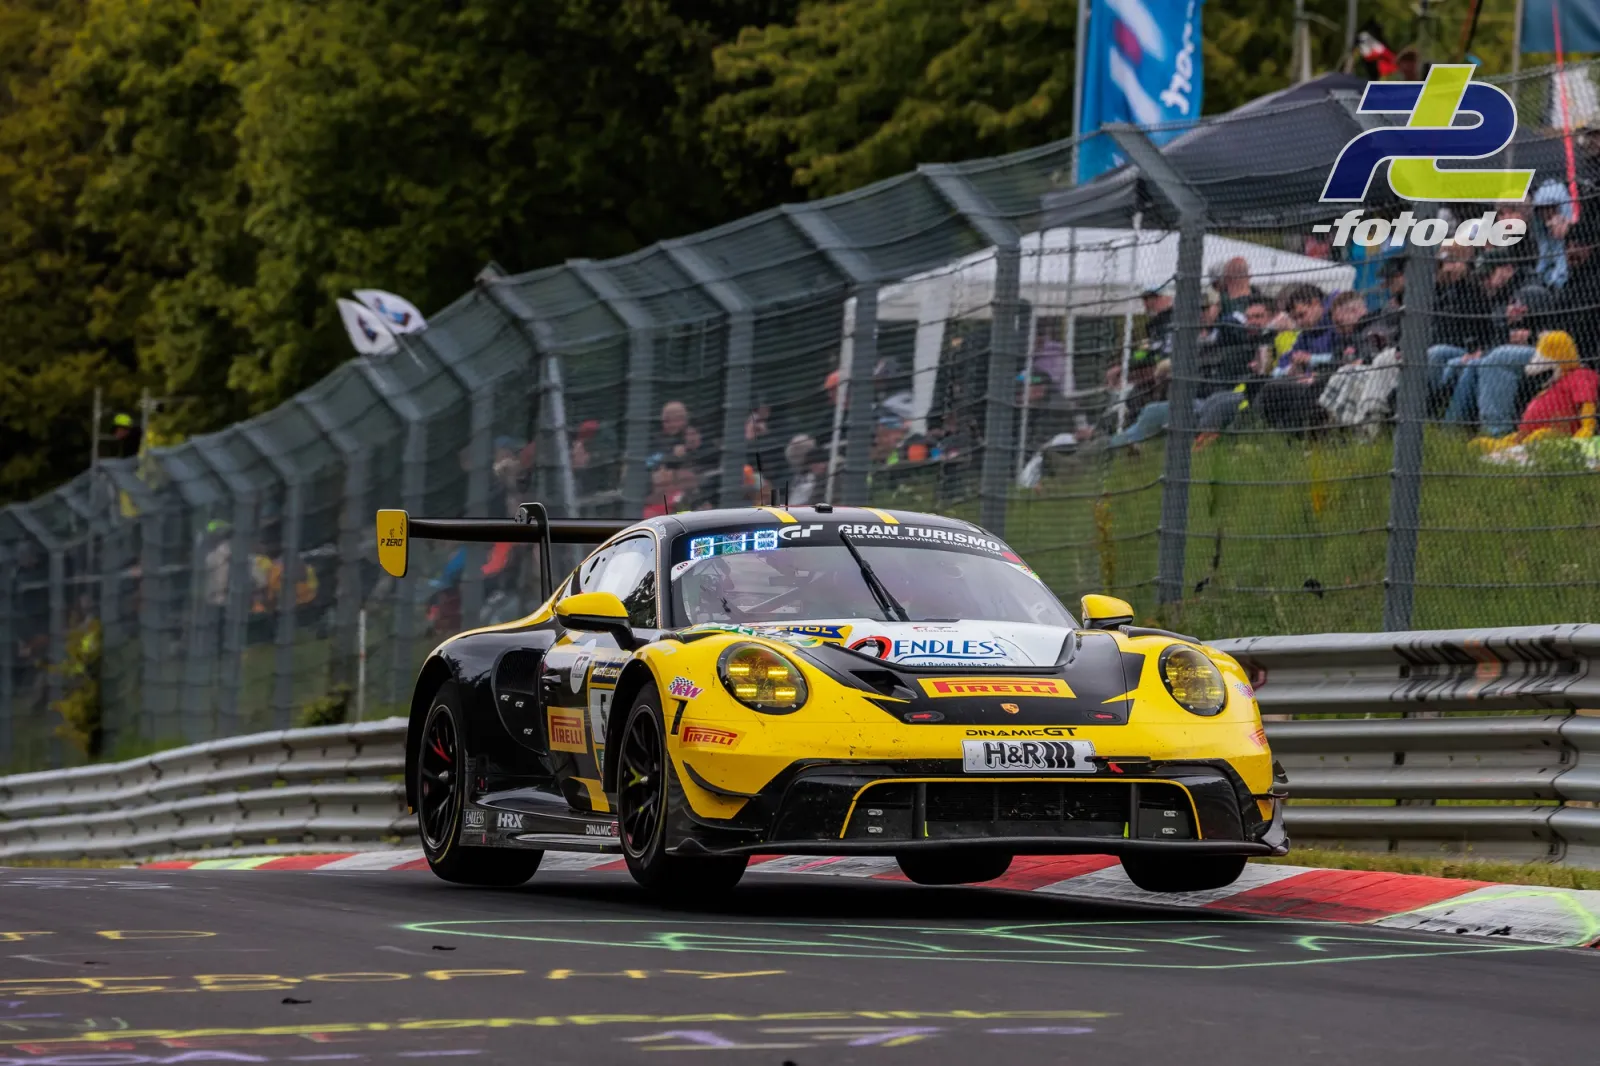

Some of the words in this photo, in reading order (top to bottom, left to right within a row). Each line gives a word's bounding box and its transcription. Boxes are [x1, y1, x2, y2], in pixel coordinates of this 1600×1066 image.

[386, 538, 404, 547] ZERO
[838, 524, 899, 535] GRAN
[904, 526, 1001, 551] TURISMO
[897, 536, 942, 545] DRIVING
[894, 640, 1007, 657] ENDLESS
[933, 680, 1059, 694] PIRELLI
[550, 715, 584, 745] PIRELLI
[683, 726, 738, 746] PIRELLI
[983, 742, 1043, 767] H&R
[465, 811, 485, 825] ENDLESS
[497, 812, 524, 829] HRX
